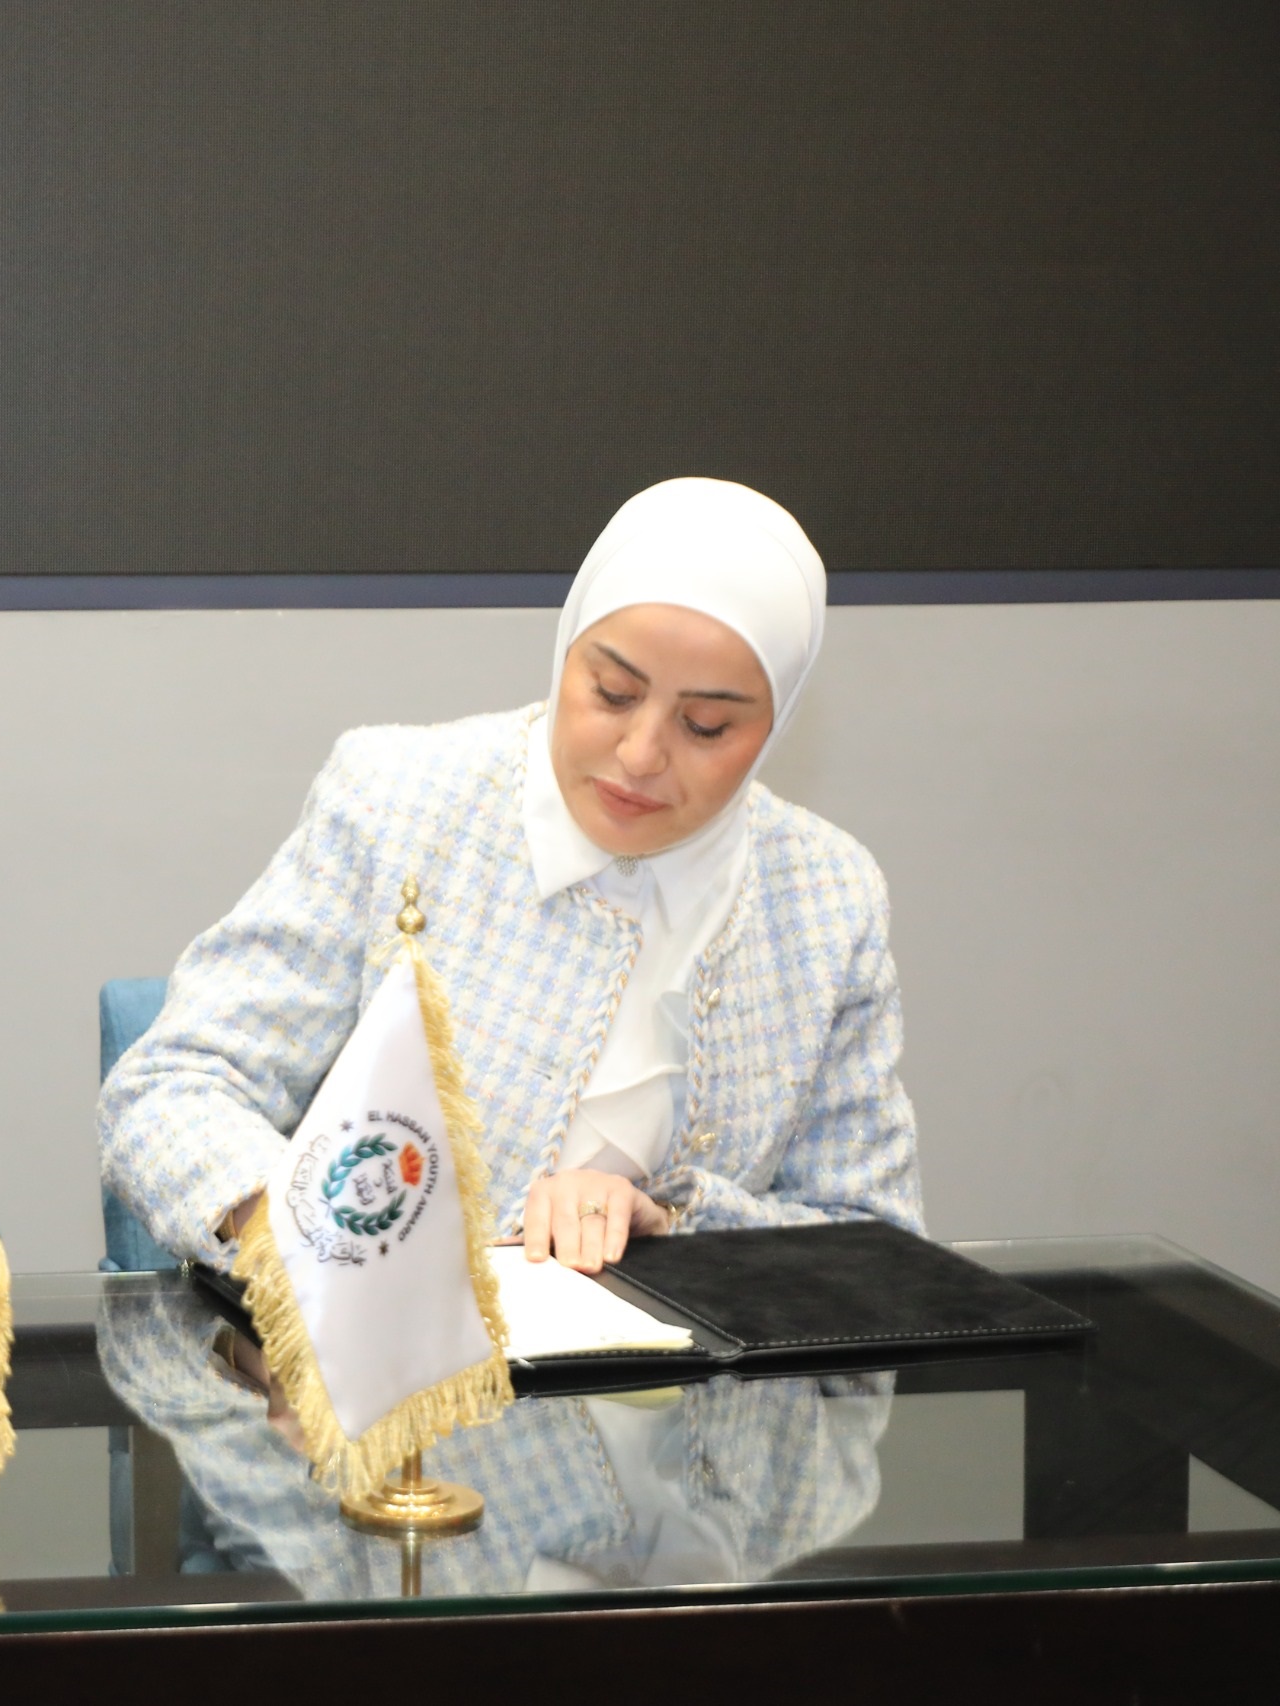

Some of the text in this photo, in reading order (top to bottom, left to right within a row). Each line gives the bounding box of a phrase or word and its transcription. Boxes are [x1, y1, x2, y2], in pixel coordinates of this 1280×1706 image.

[367, 1110, 383, 1122] EL
[424, 1143, 439, 1195] YOUTH
[397, 1196, 428, 1242] AWARD
